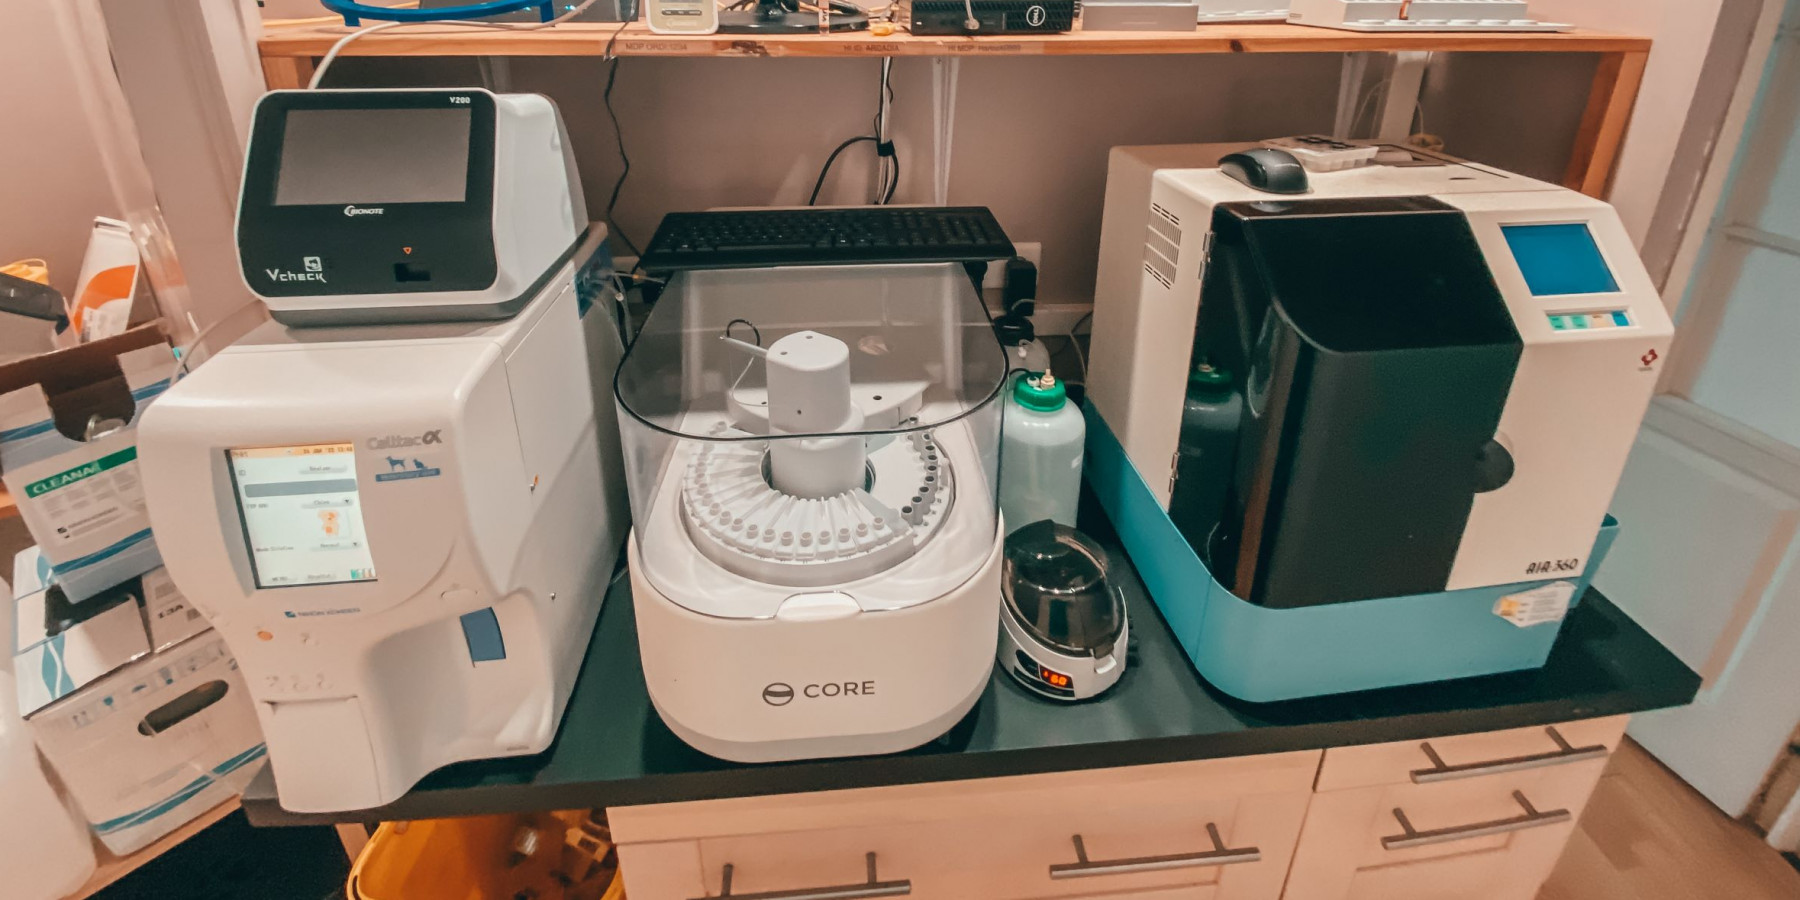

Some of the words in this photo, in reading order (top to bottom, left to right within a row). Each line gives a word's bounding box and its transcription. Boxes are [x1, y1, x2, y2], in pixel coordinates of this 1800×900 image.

[449, 96, 471, 104] V200
[347, 206, 384, 216] BIONOTE
[803, 680, 876, 698] CORE
